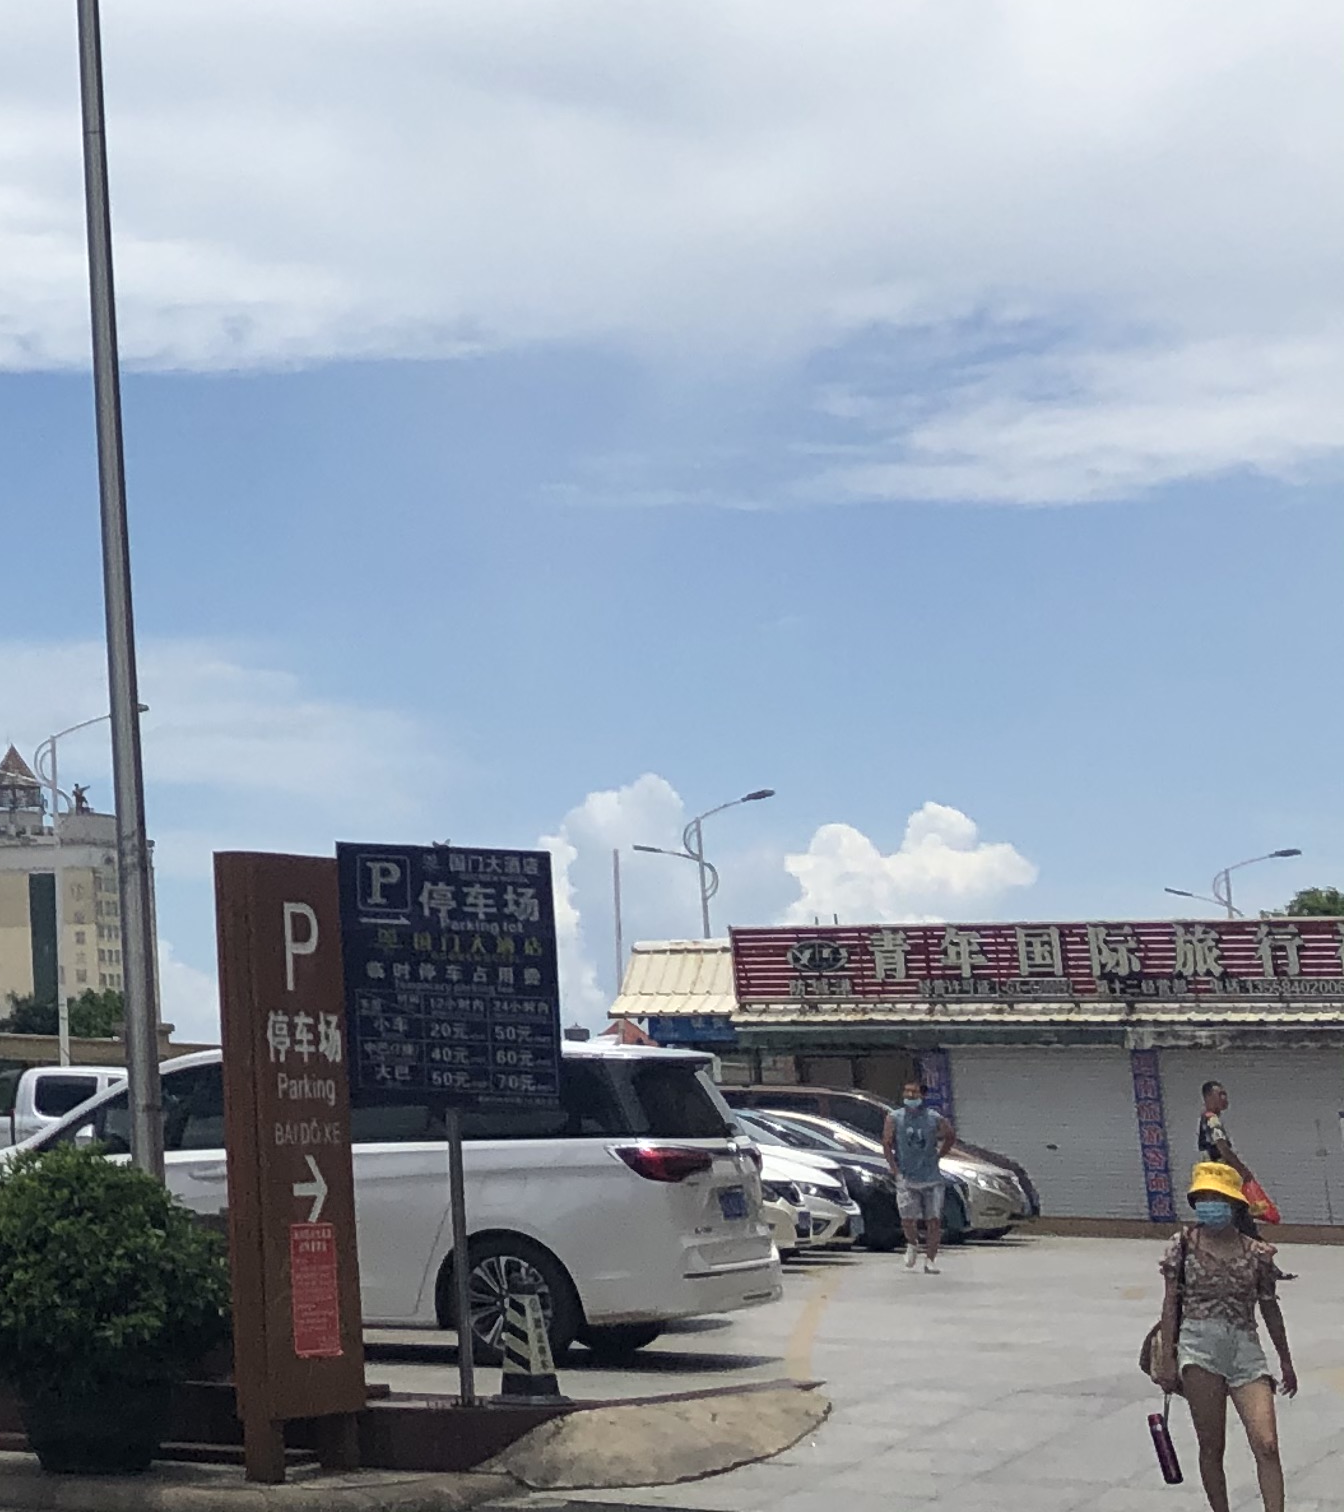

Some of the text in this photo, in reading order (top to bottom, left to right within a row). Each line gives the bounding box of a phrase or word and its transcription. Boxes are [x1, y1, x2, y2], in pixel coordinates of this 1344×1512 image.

[366, 861, 401, 905] P
[449, 854, 539, 875] 国门大酒店
[418, 880, 541, 923] 停车场
[283, 901, 319, 991] P
[267, 1009, 342, 1063] 停车场
[277, 1072, 336, 1107] Parking
